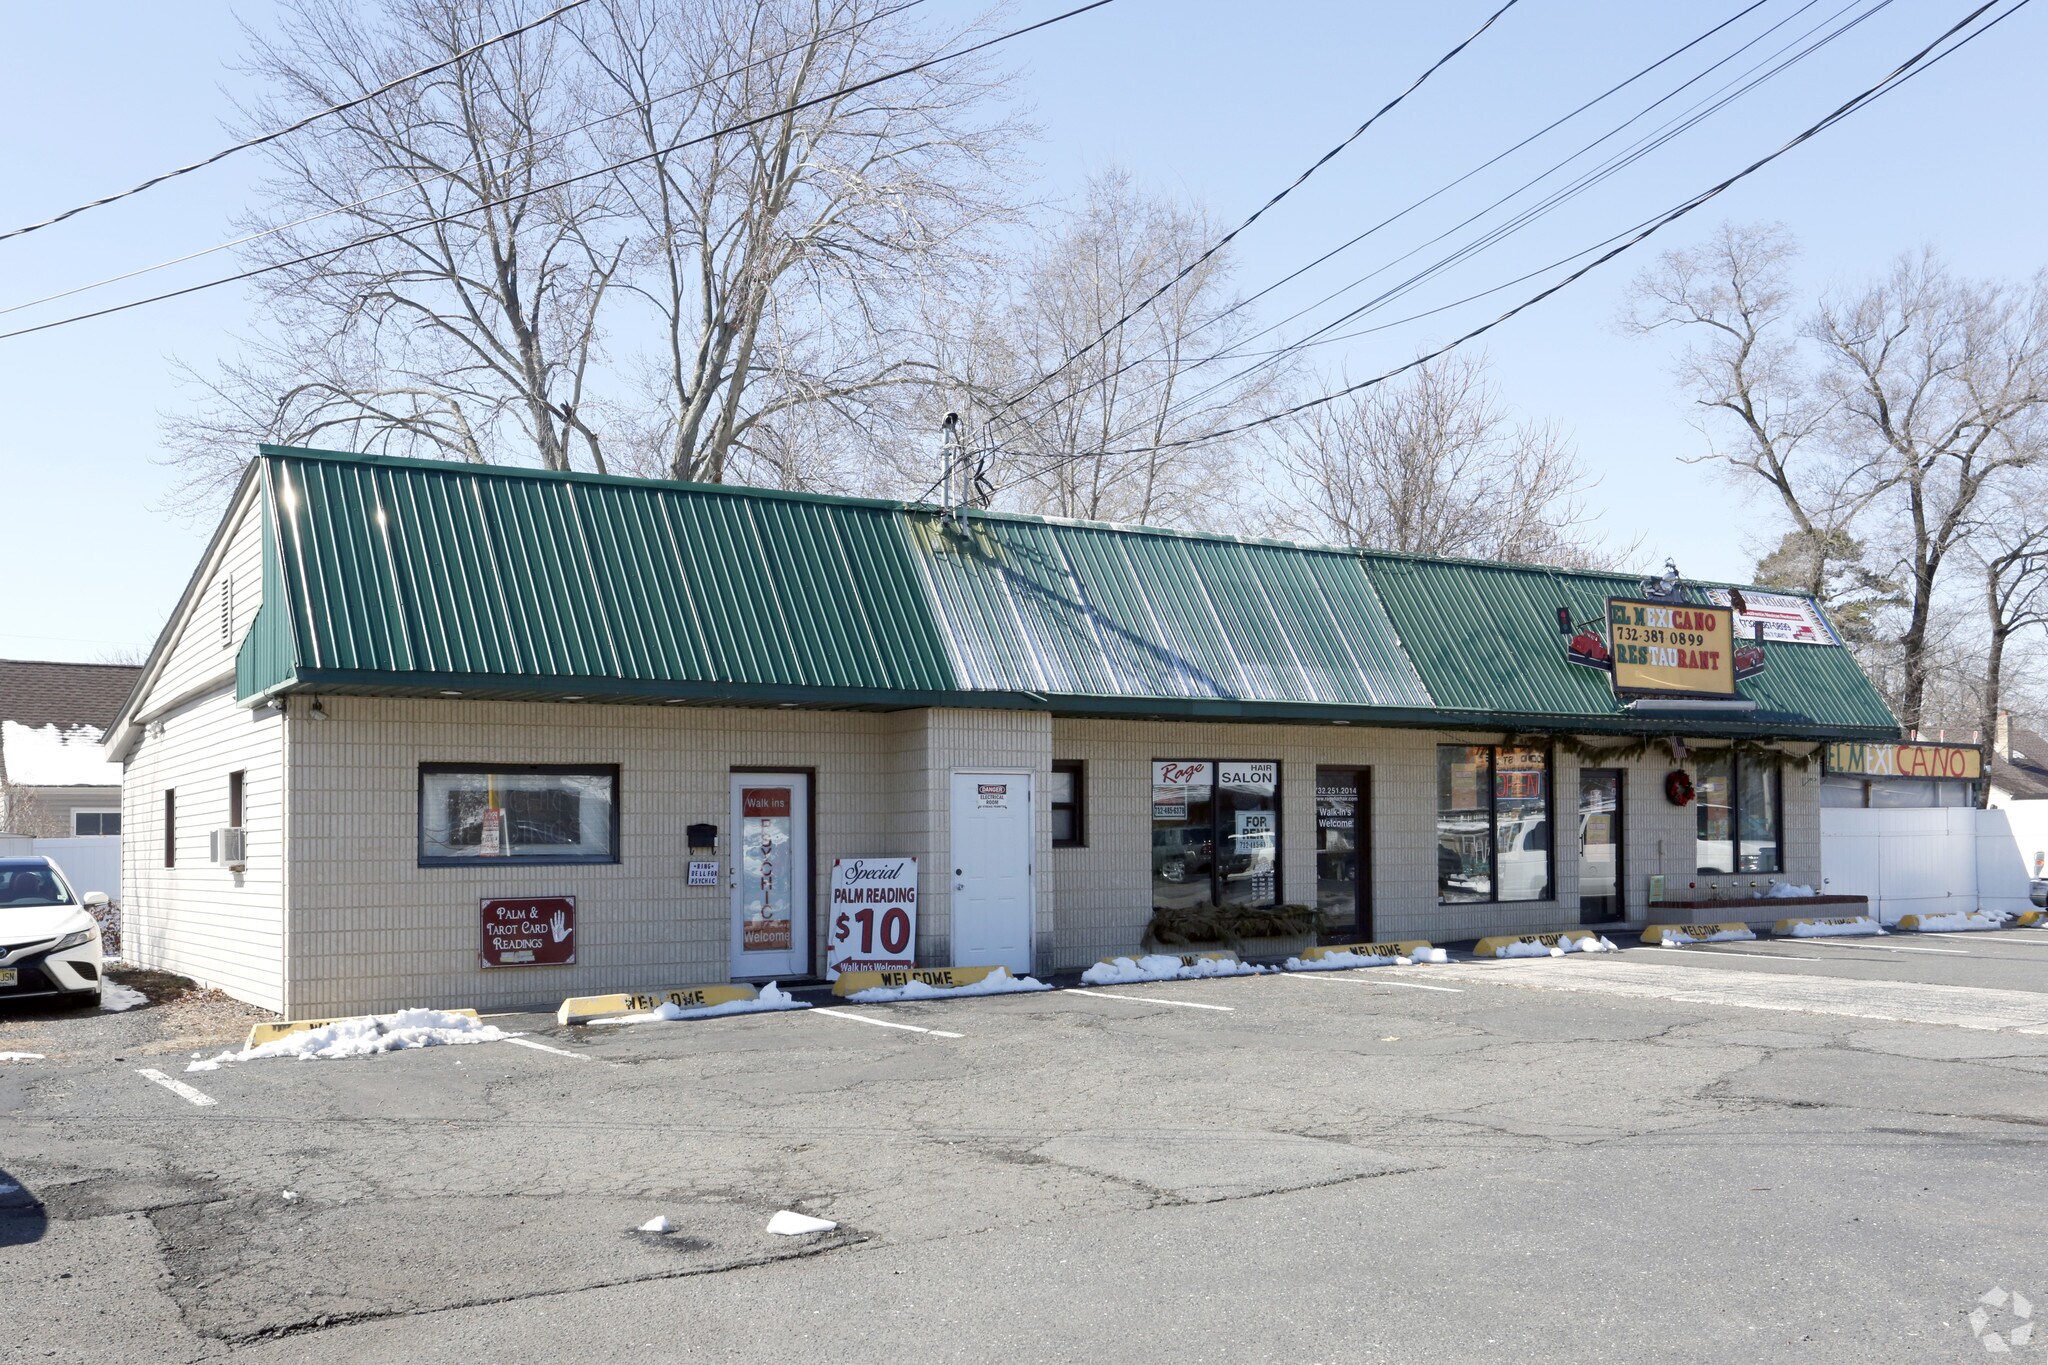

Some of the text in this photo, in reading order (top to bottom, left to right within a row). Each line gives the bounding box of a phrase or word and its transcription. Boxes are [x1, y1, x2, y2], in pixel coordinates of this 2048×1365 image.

[1611, 605, 1716, 631] EL MEXICANO
[1616, 644, 1719, 670] RESTAURANT
[1827, 742, 1965, 778] EL MEXICANO
[1161, 763, 1204, 784] Rage
[1251, 764, 1272, 772] HAIR
[1222, 772, 1272, 783] SALON
[1496, 773, 1538, 796] OPEN
[747, 797, 785, 808] Walk ins
[1246, 816, 1267, 827] FOR
[1319, 819, 1353, 828] Welcome
[761, 819, 773, 919] PSYCHIC
[845, 860, 904, 885] Special
[834, 887, 915, 904] PALM READING
[529, 906, 539, 919] &
[744, 930, 790, 943] Welcome
[1349, 944, 1402, 956] WELCOME
[840, 962, 908, 972] Walk In's Welcome
